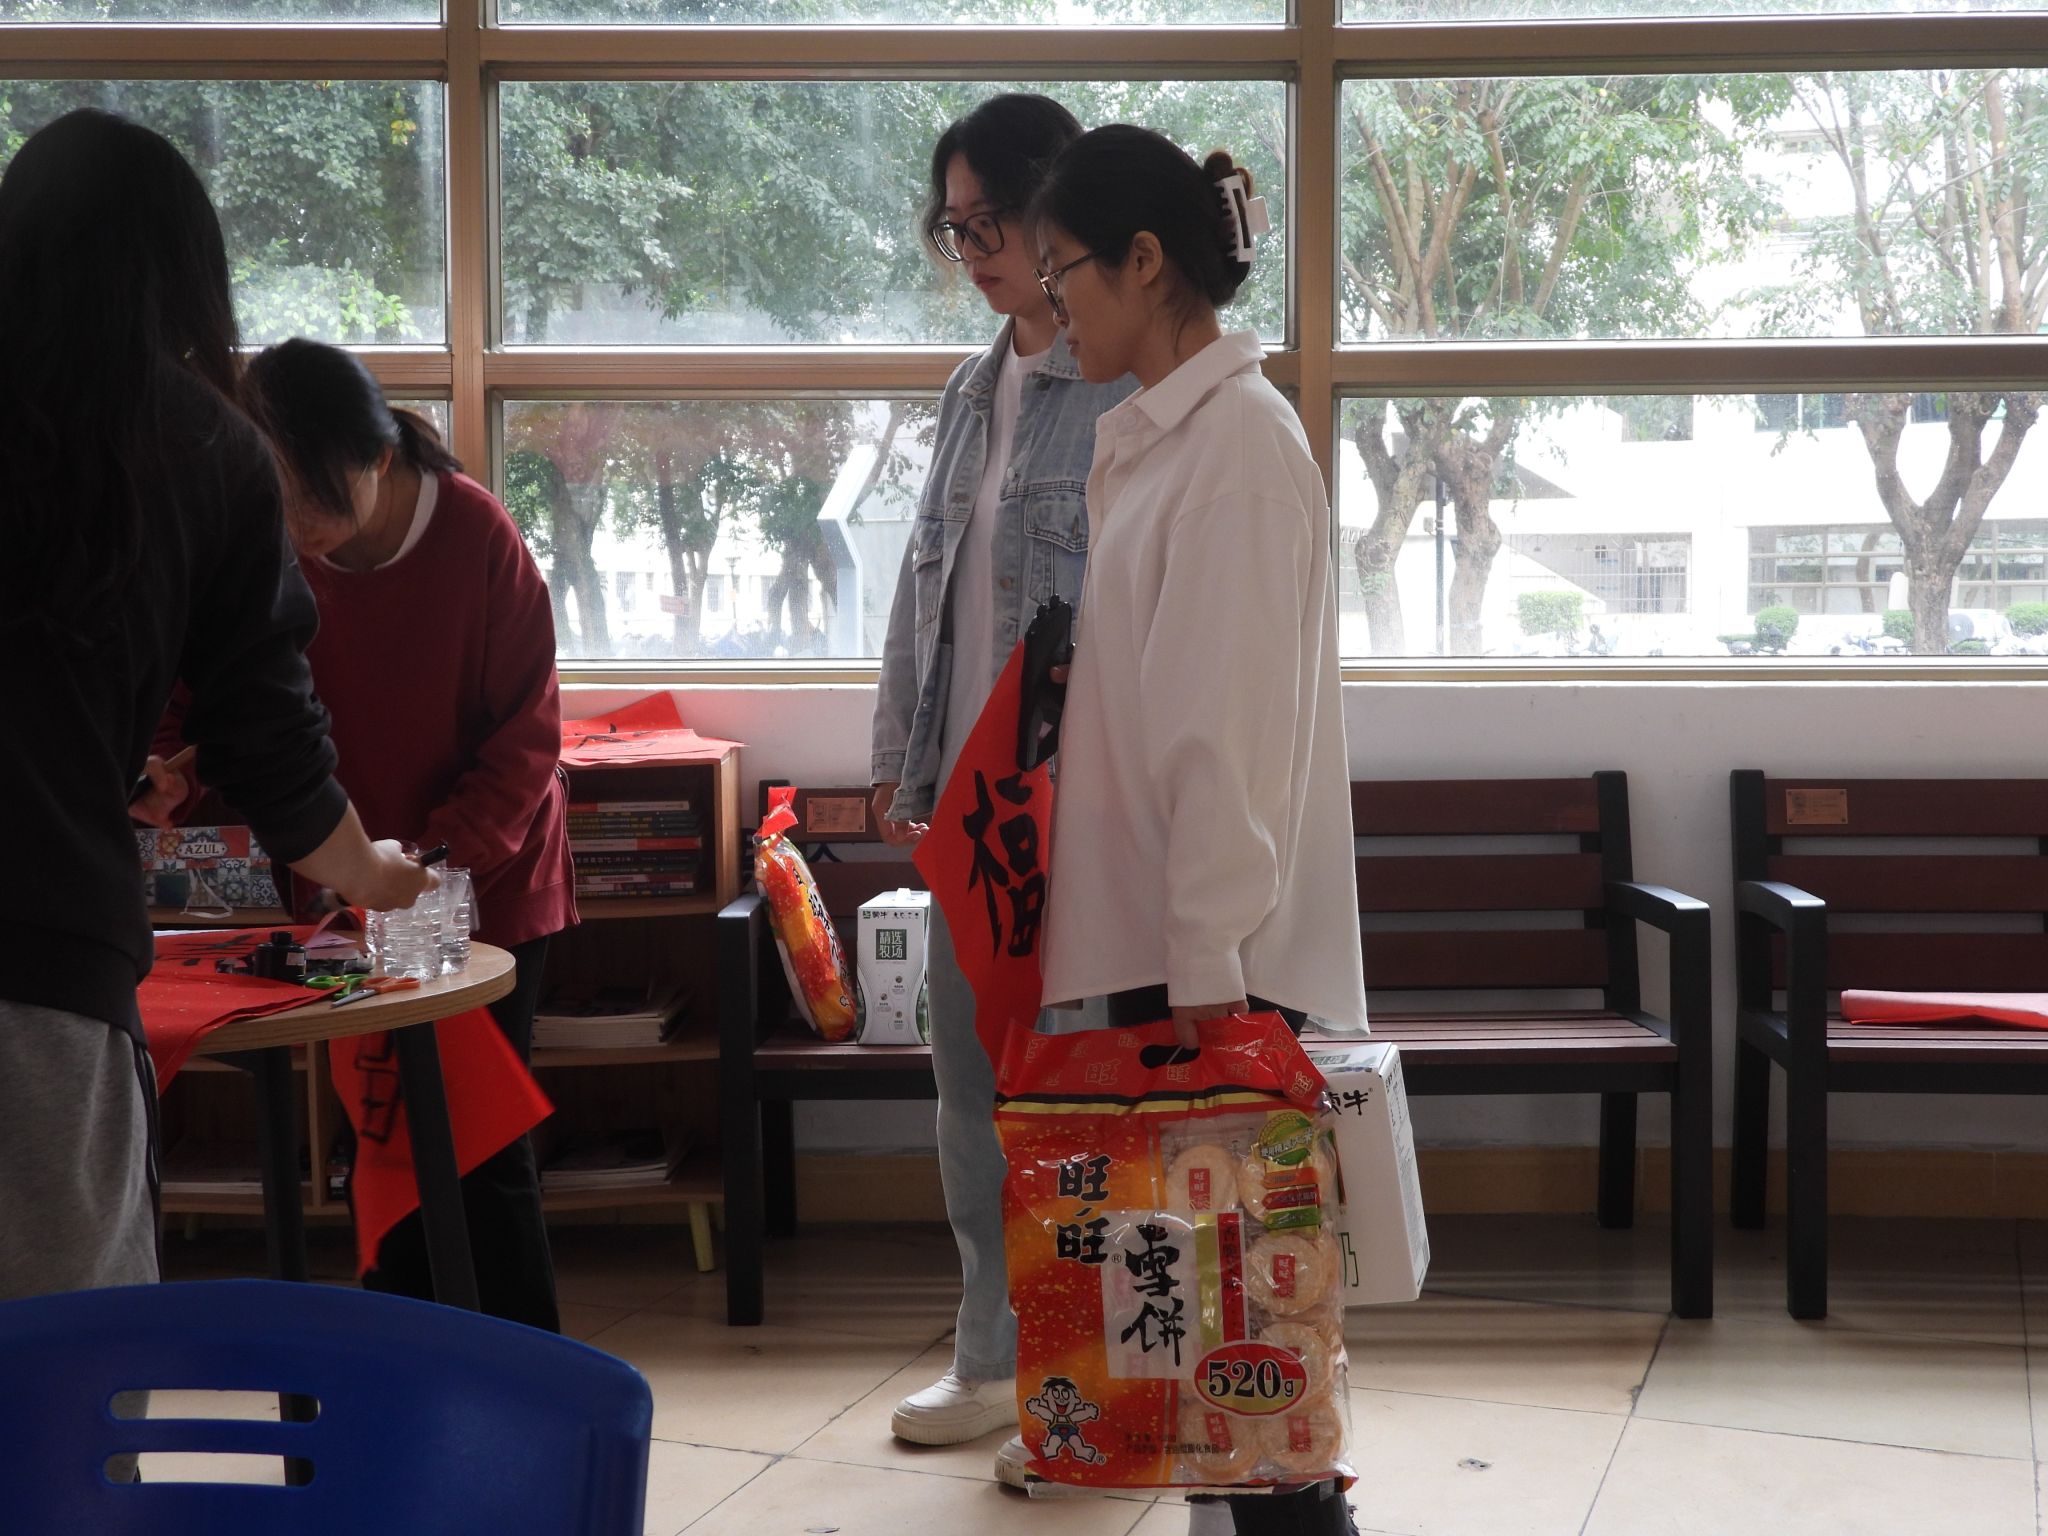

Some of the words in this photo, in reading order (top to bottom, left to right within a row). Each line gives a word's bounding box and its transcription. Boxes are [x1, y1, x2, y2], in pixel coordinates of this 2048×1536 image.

[184, 843, 220, 855] AZUL
[1056, 1154, 1112, 1264] 旺旺
[1121, 1224, 1187, 1367] 雪饼
